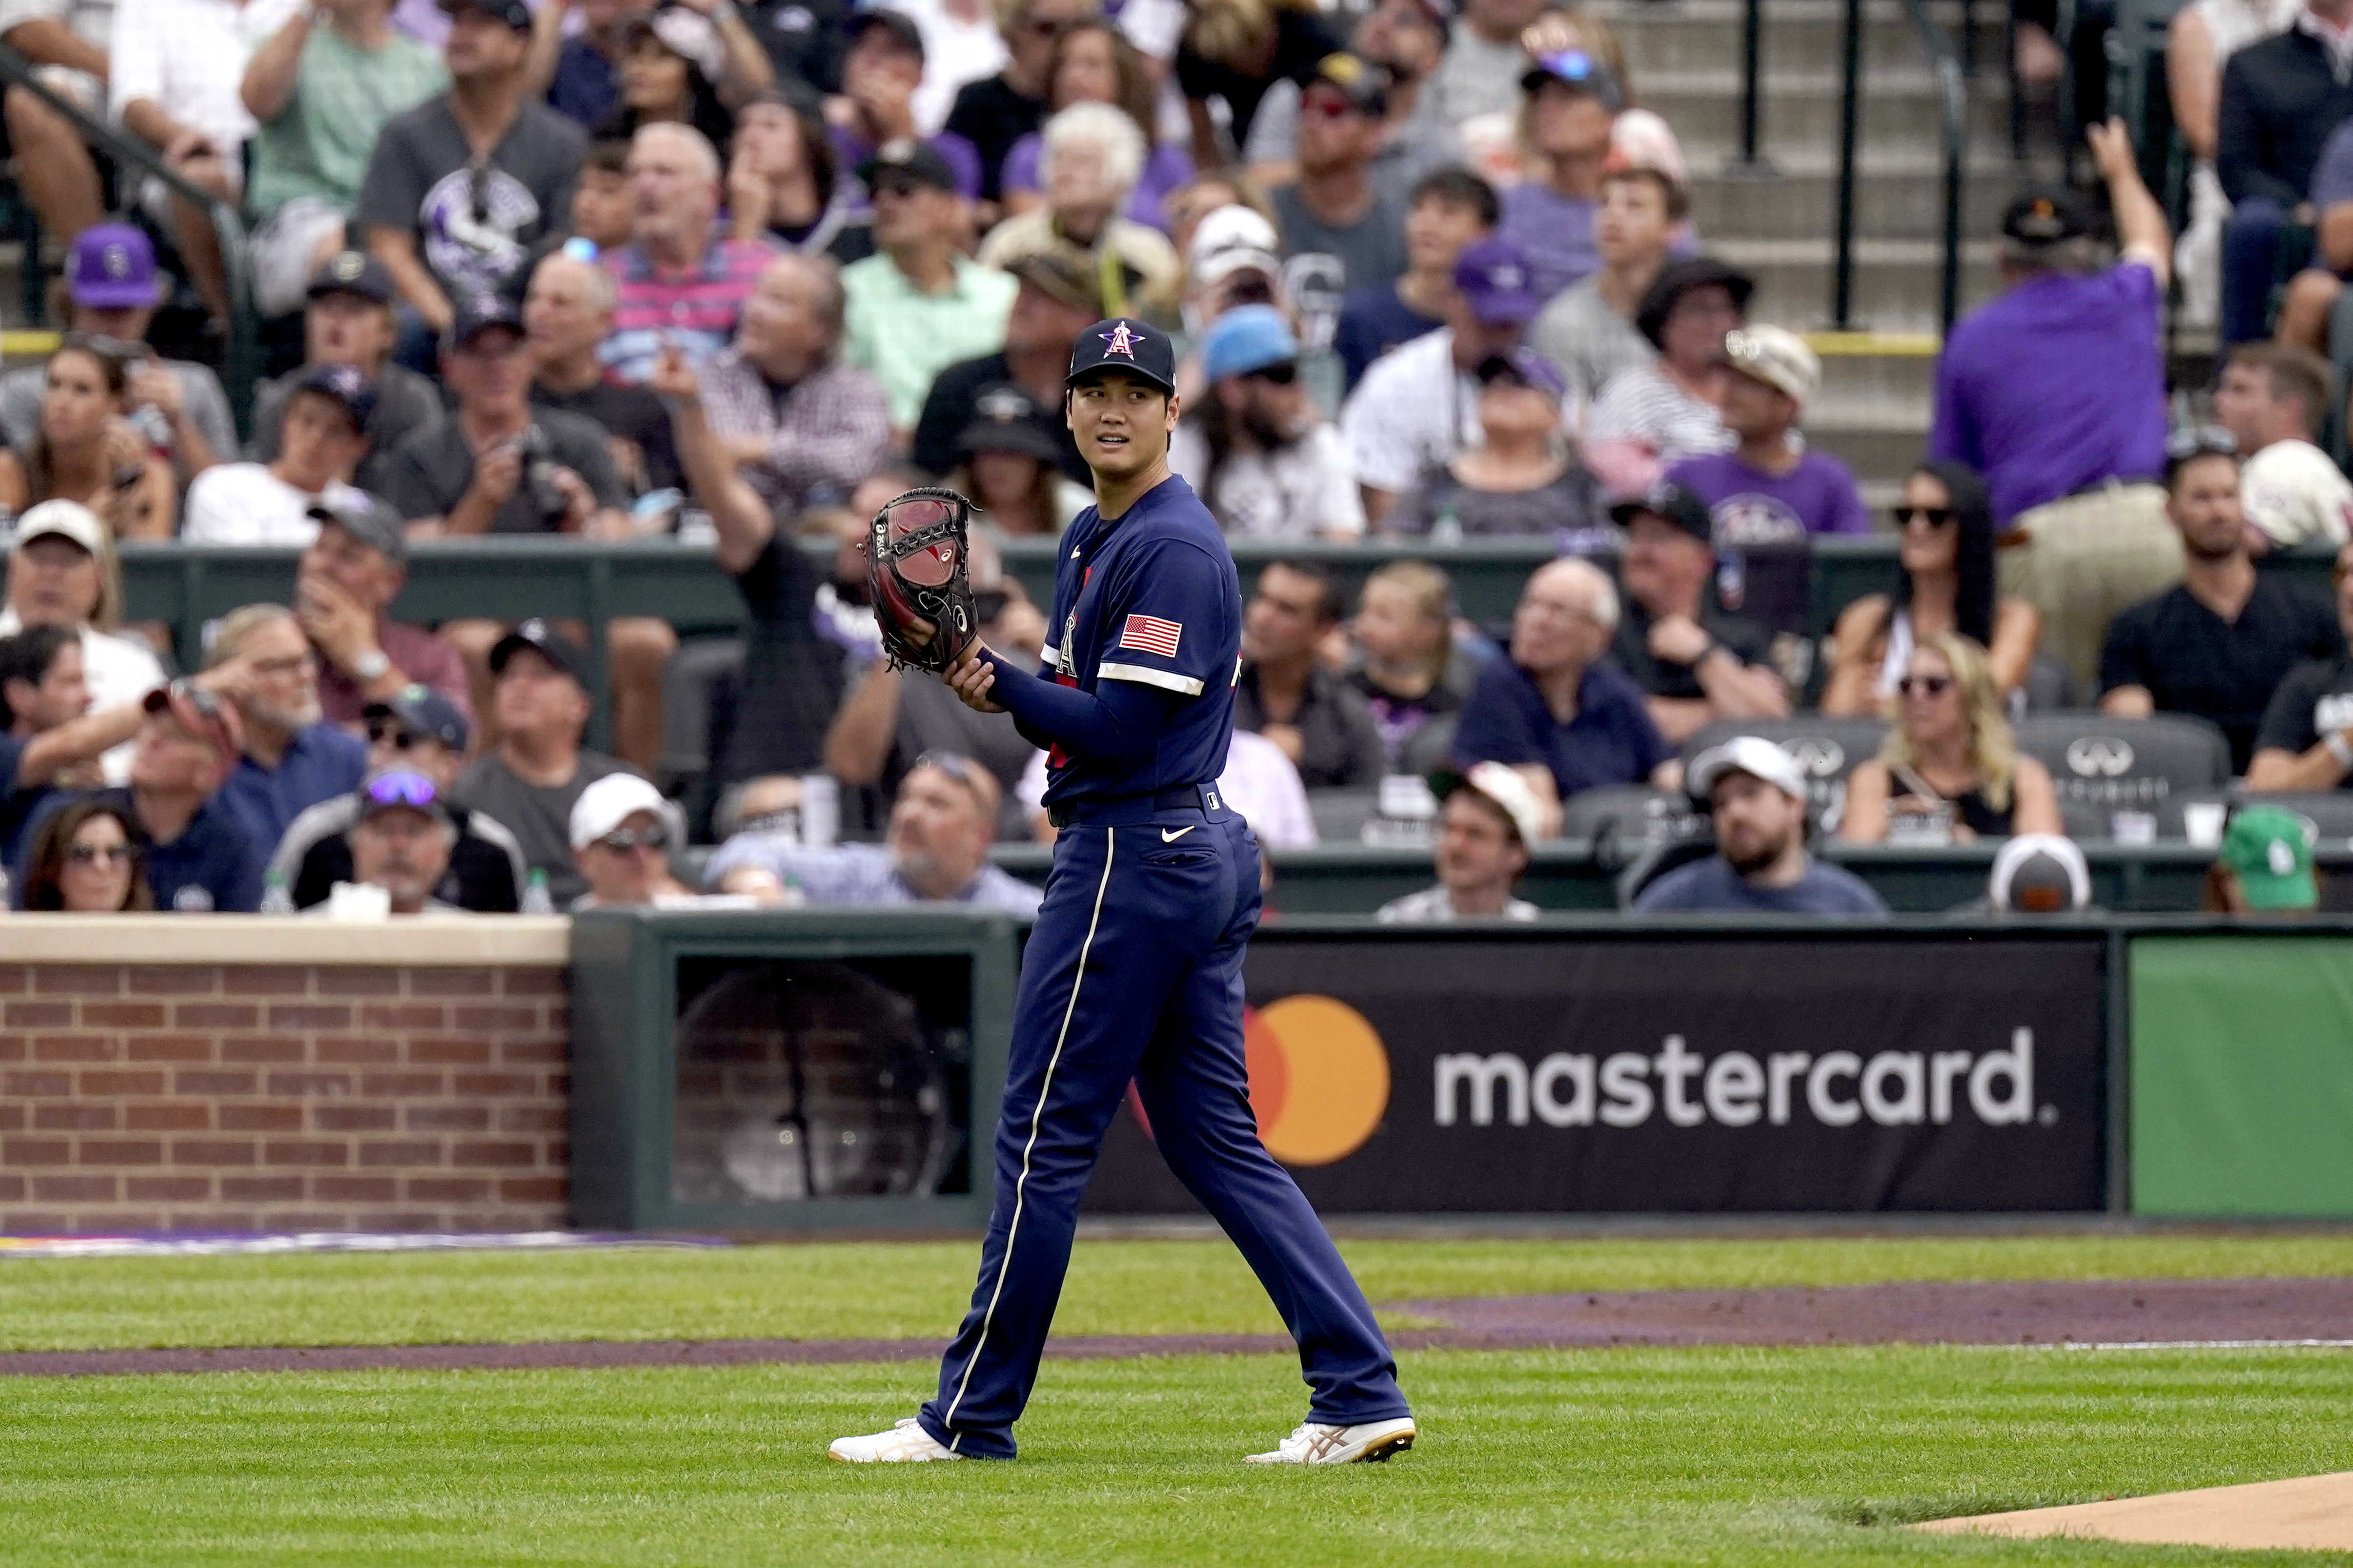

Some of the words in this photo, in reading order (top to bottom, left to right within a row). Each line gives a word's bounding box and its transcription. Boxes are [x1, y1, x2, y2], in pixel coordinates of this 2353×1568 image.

[1108, 325, 1133, 355] A
[876, 534, 885, 558] asics
[1056, 614, 1078, 678] A
